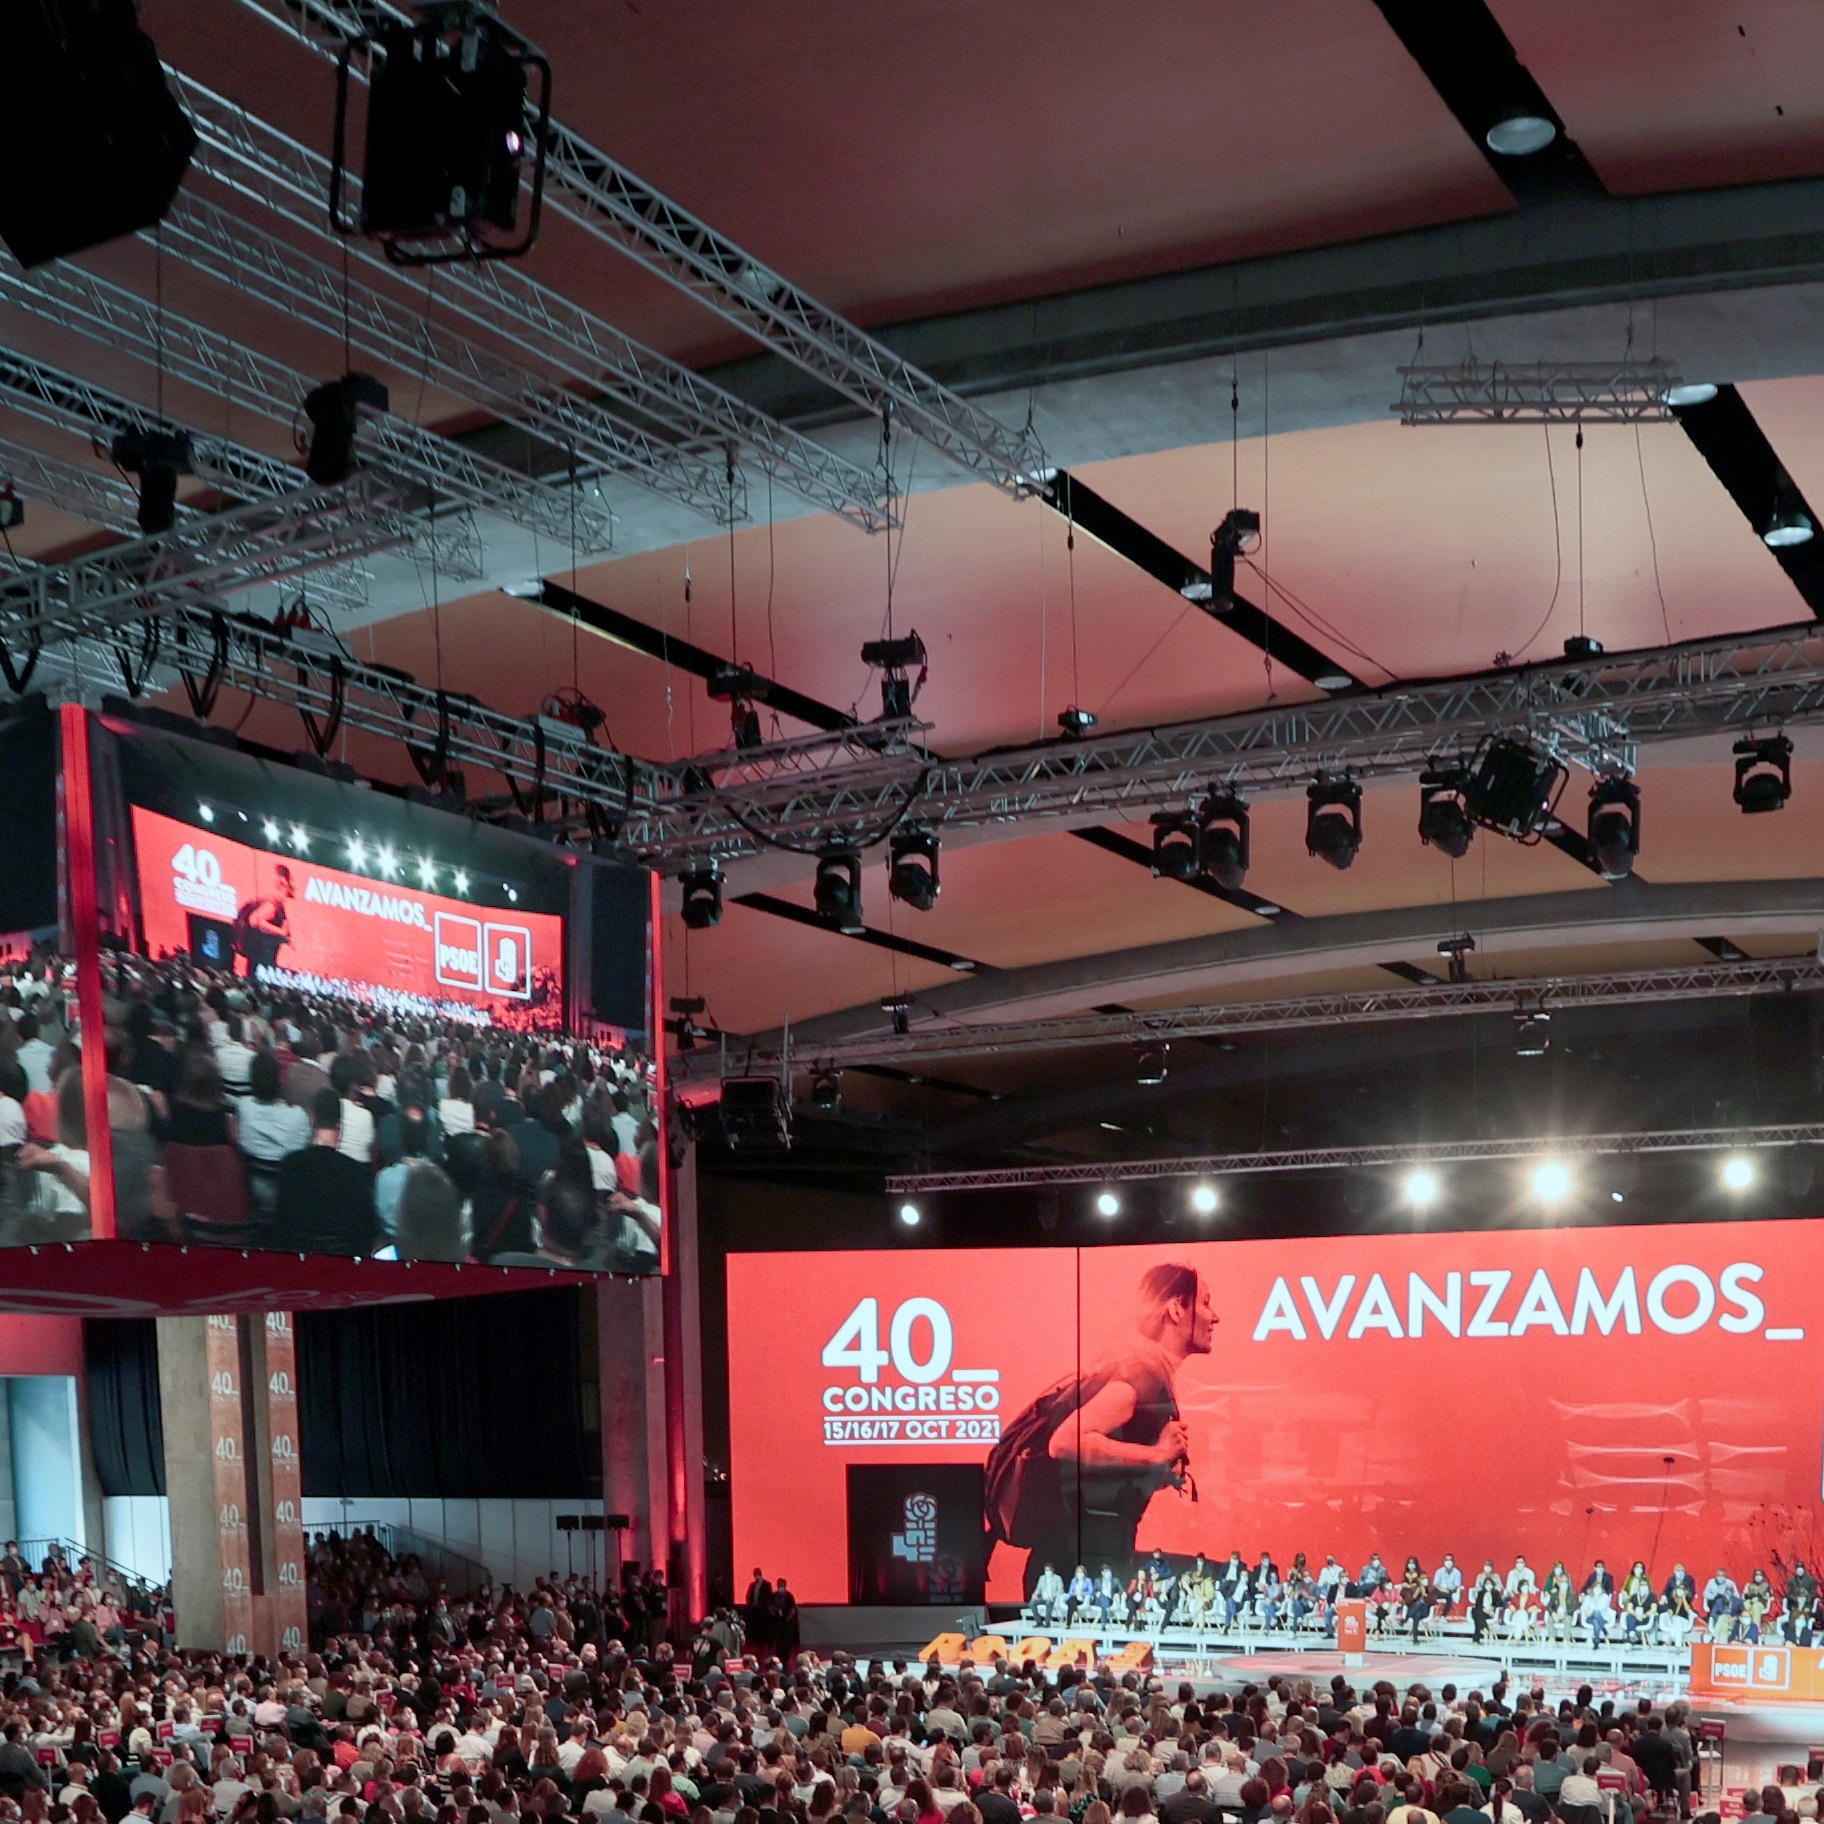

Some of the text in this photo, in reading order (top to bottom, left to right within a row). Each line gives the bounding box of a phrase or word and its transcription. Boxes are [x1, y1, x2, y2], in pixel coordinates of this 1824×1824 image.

[440, 943, 479, 974] PSOE
[822, 1385, 1000, 1412] CONGRESO
[824, 1420, 1000, 1439] 15/16/17 OCT 2021
[1714, 1663, 1747, 1678] PSOE
